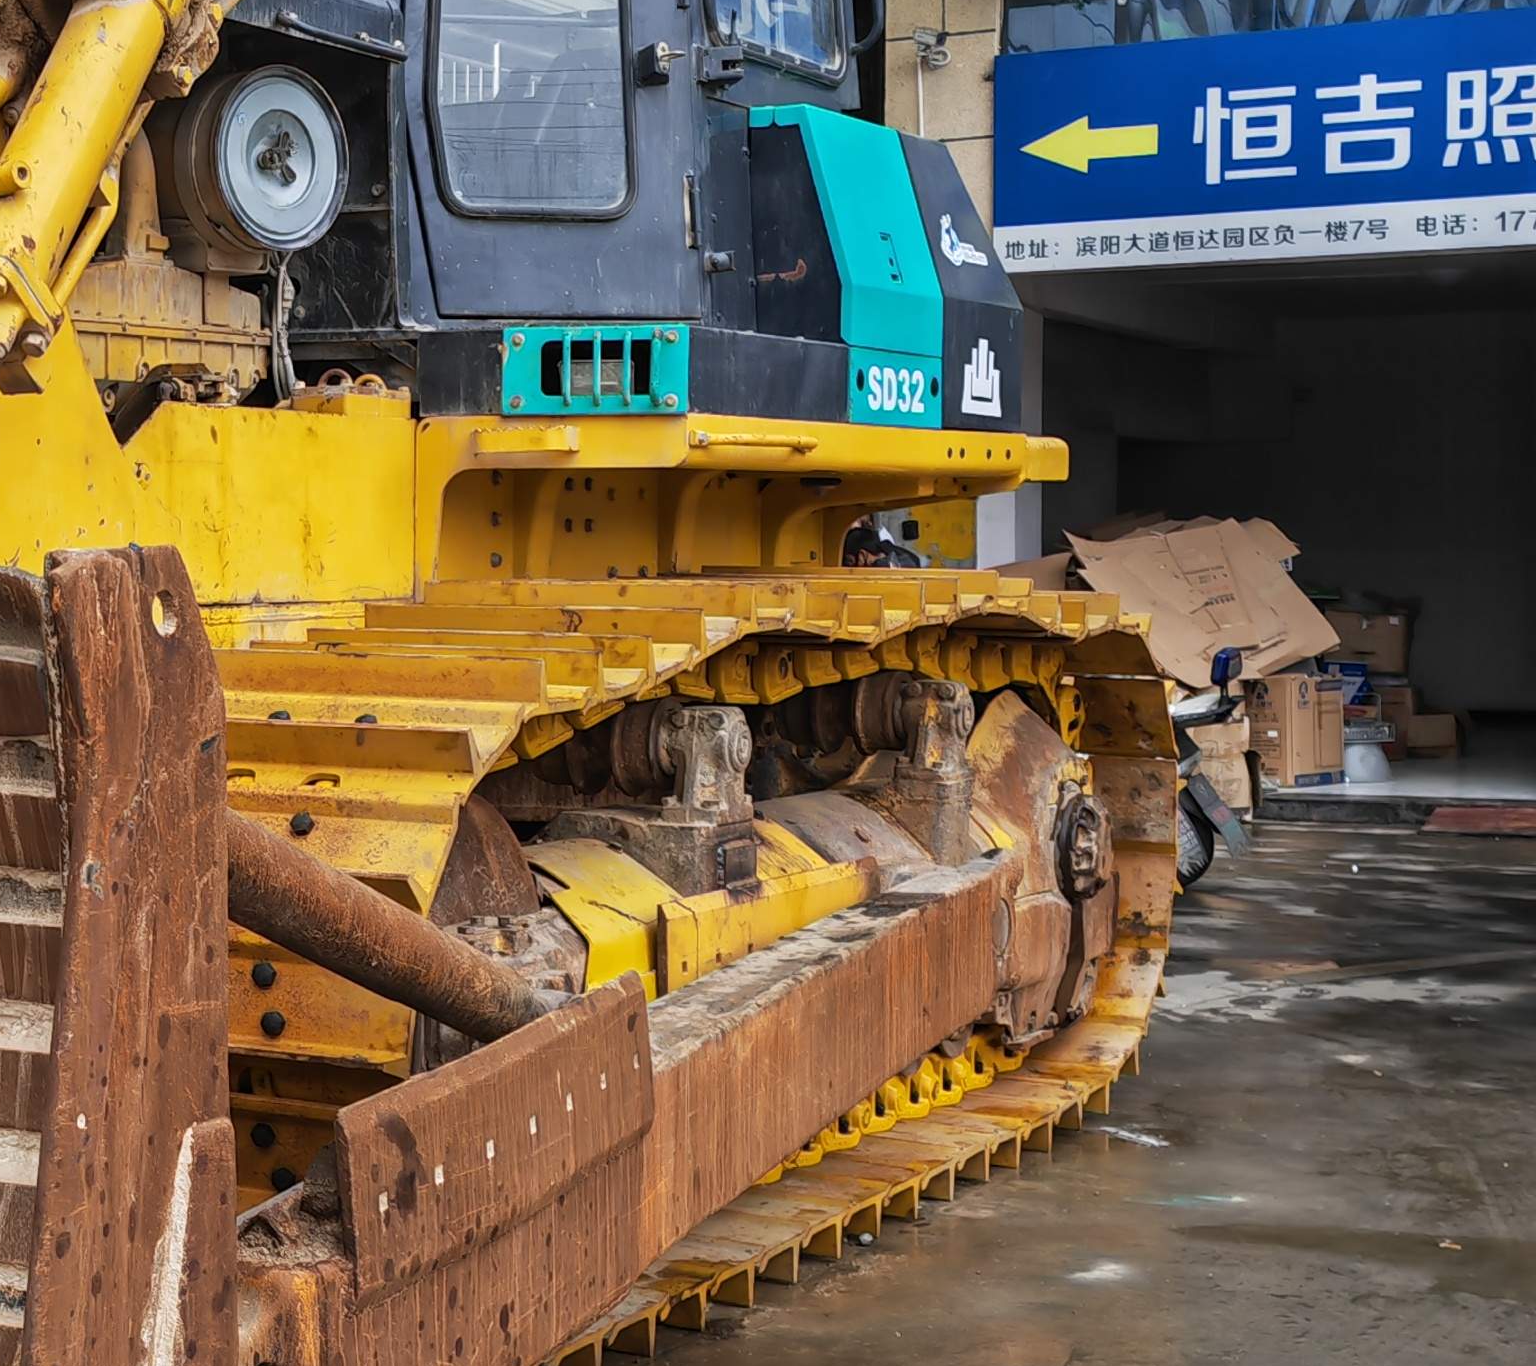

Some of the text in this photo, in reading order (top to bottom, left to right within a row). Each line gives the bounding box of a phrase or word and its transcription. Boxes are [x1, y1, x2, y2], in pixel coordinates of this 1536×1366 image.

[1193, 65, 1536, 185] 恒吉照
[867, 365, 925, 413] SD32
